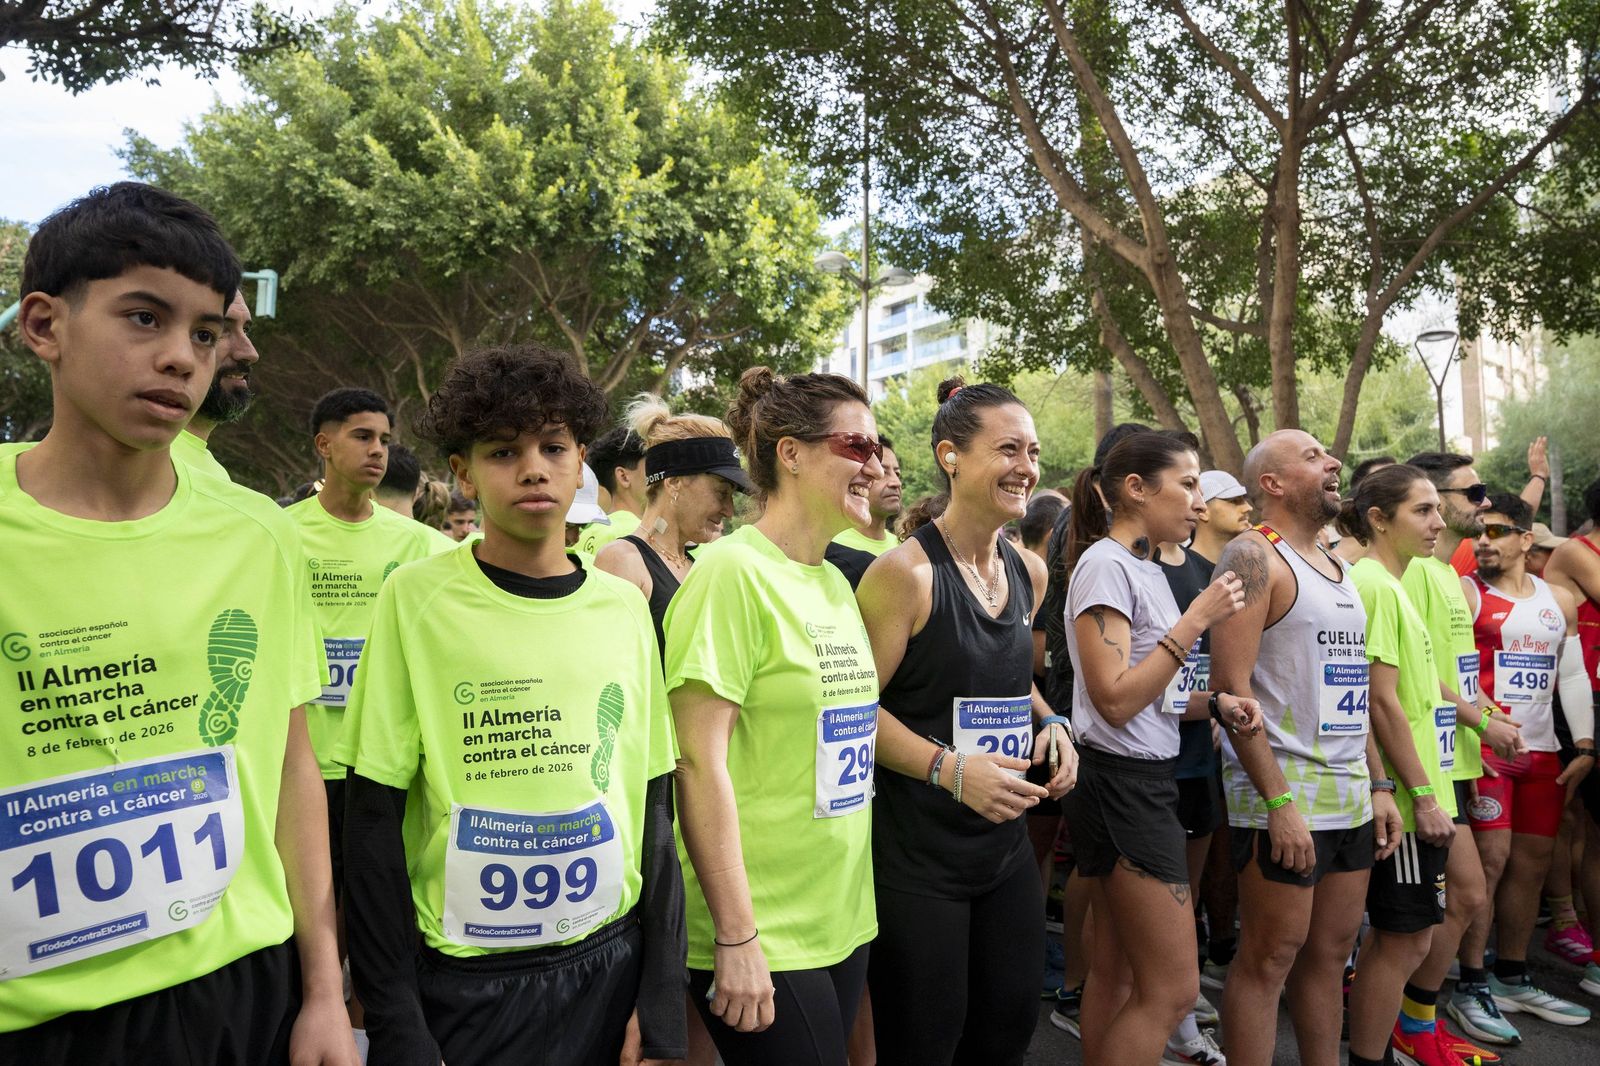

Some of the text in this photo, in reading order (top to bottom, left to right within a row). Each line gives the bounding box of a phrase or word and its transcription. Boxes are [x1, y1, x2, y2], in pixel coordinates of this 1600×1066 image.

[312, 572, 362, 581] II Almería
[38, 620, 128, 639] asociación española
[40, 632, 112, 649] contra el cáncer
[39, 644, 90, 658] en Almería
[815, 644, 824, 657] II
[1328, 648, 1352, 657] STONE
[833, 657, 858, 668] marcha
[17, 654, 157, 691] II Almería
[821, 672, 848, 683] contra
[849, 670, 856, 680] el
[1509, 672, 1549, 690] 498
[20, 682, 145, 713] en marcha
[1337, 690, 1368, 715] 44
[22, 693, 199, 735] contra el cáncer
[463, 706, 562, 729] II Almería
[836, 711, 863, 723] Almería
[974, 705, 1009, 713] Almería
[971, 716, 1001, 724] contra
[27, 722, 174, 757] 8 de febrero de 2026
[463, 726, 552, 746] en marcha
[834, 726, 857, 736] contra
[858, 724, 865, 733] el
[463, 742, 590, 763] contra el cáncer
[976, 732, 1029, 759] 292
[466, 762, 573, 781] 8 de febrero de 2026
[6, 765, 208, 817] II Almería en marcha
[19, 787, 187, 837] contra el cáncer
[470, 812, 602, 834] II Almería en marcha
[474, 832, 588, 849] contra el cáncer
[11, 812, 228, 919] 1011
[480, 856, 598, 911] 999
[36, 918, 142, 954] #TodosContraElCáncer
[469, 927, 537, 936] #TodosContraElCáncer
